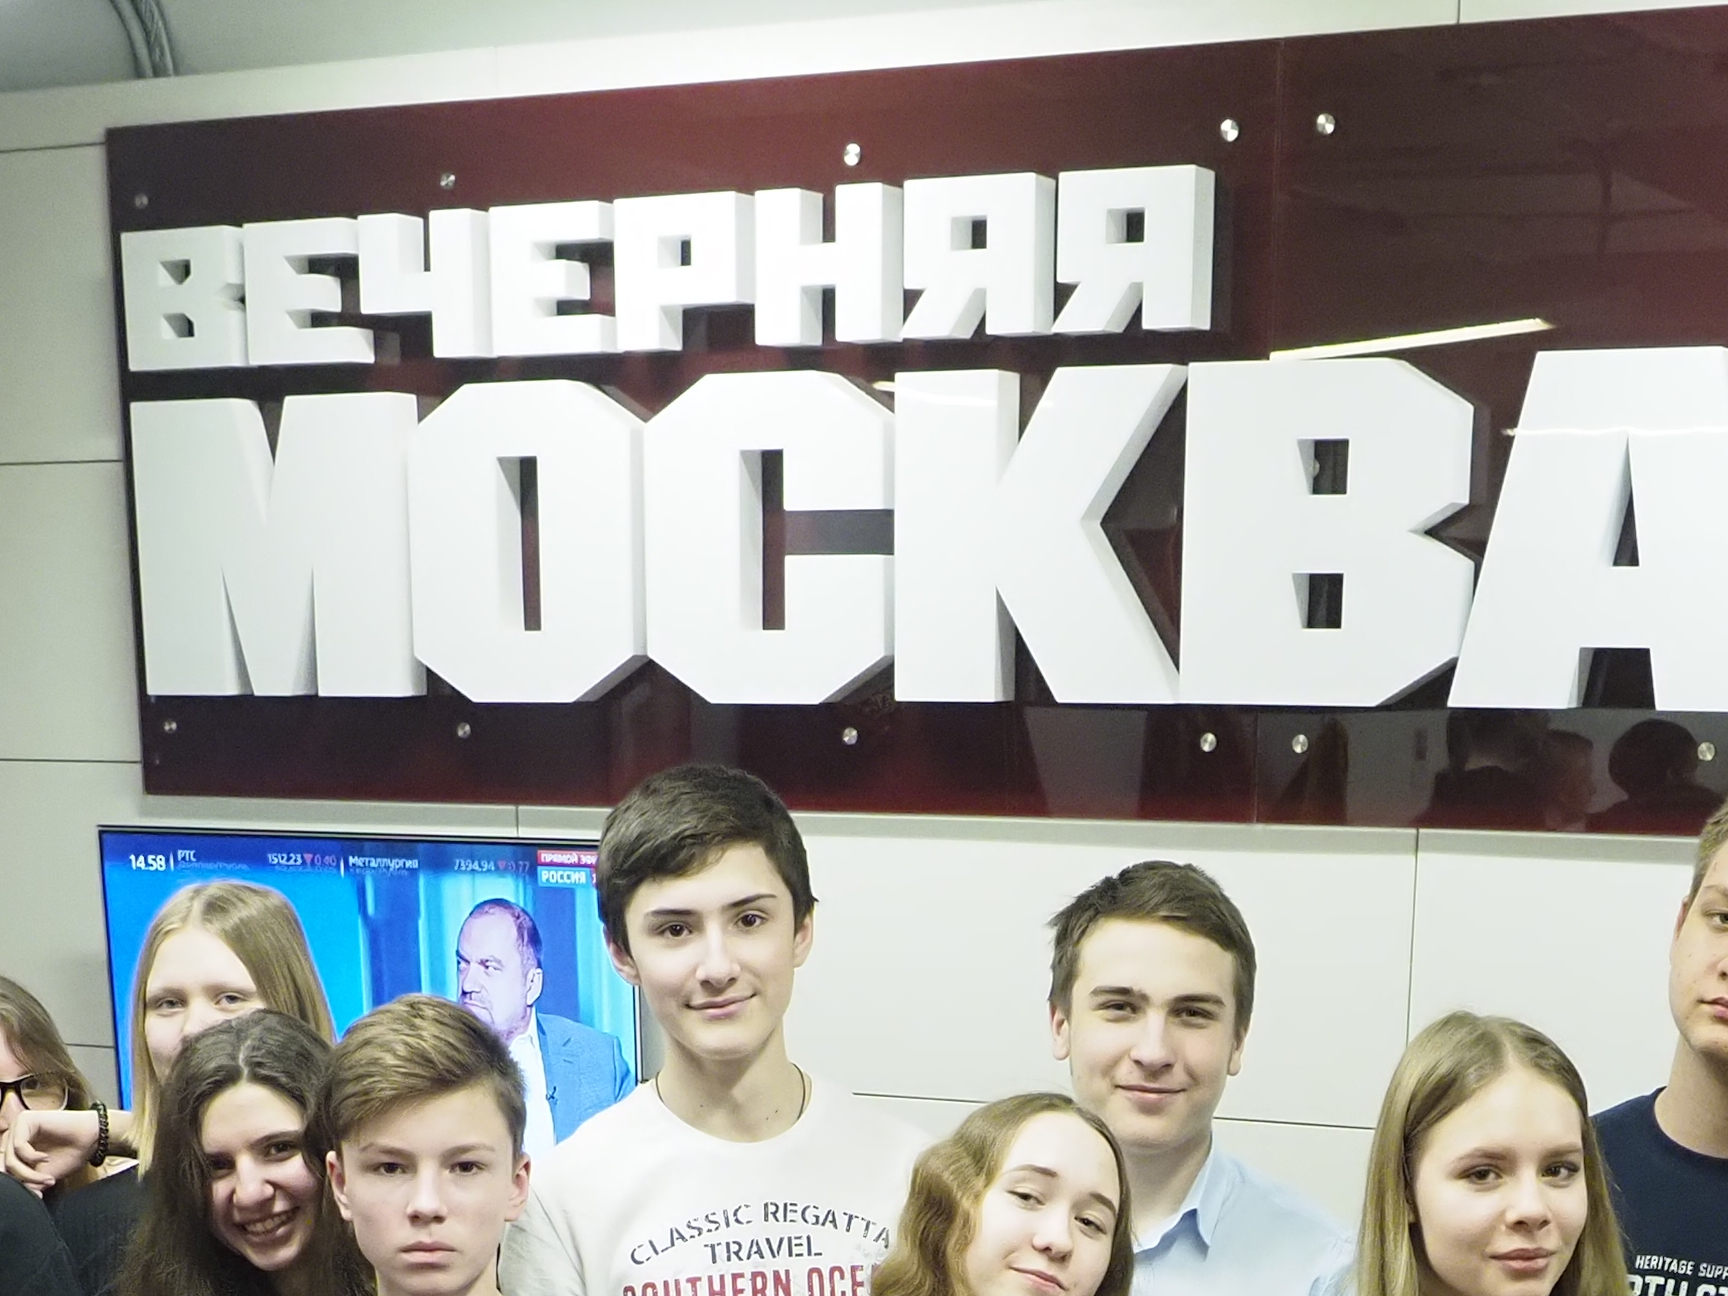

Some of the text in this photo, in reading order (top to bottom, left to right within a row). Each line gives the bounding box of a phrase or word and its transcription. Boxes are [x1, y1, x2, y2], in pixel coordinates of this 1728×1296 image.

[121, 165, 1215, 370] ВЕЧЕРНЯЯ
[177, 849, 197, 862] РТС
[348, 855, 419, 870] Металлургия
[540, 852, 578, 864] ПРЯМОЙ
[541, 870, 587, 884] РОССИЯ
[630, 1201, 891, 1266] CLASSIC REGATTA
[703, 1234, 823, 1265] TRAVEL
[1634, 1254, 1695, 1276] HERITAGE
